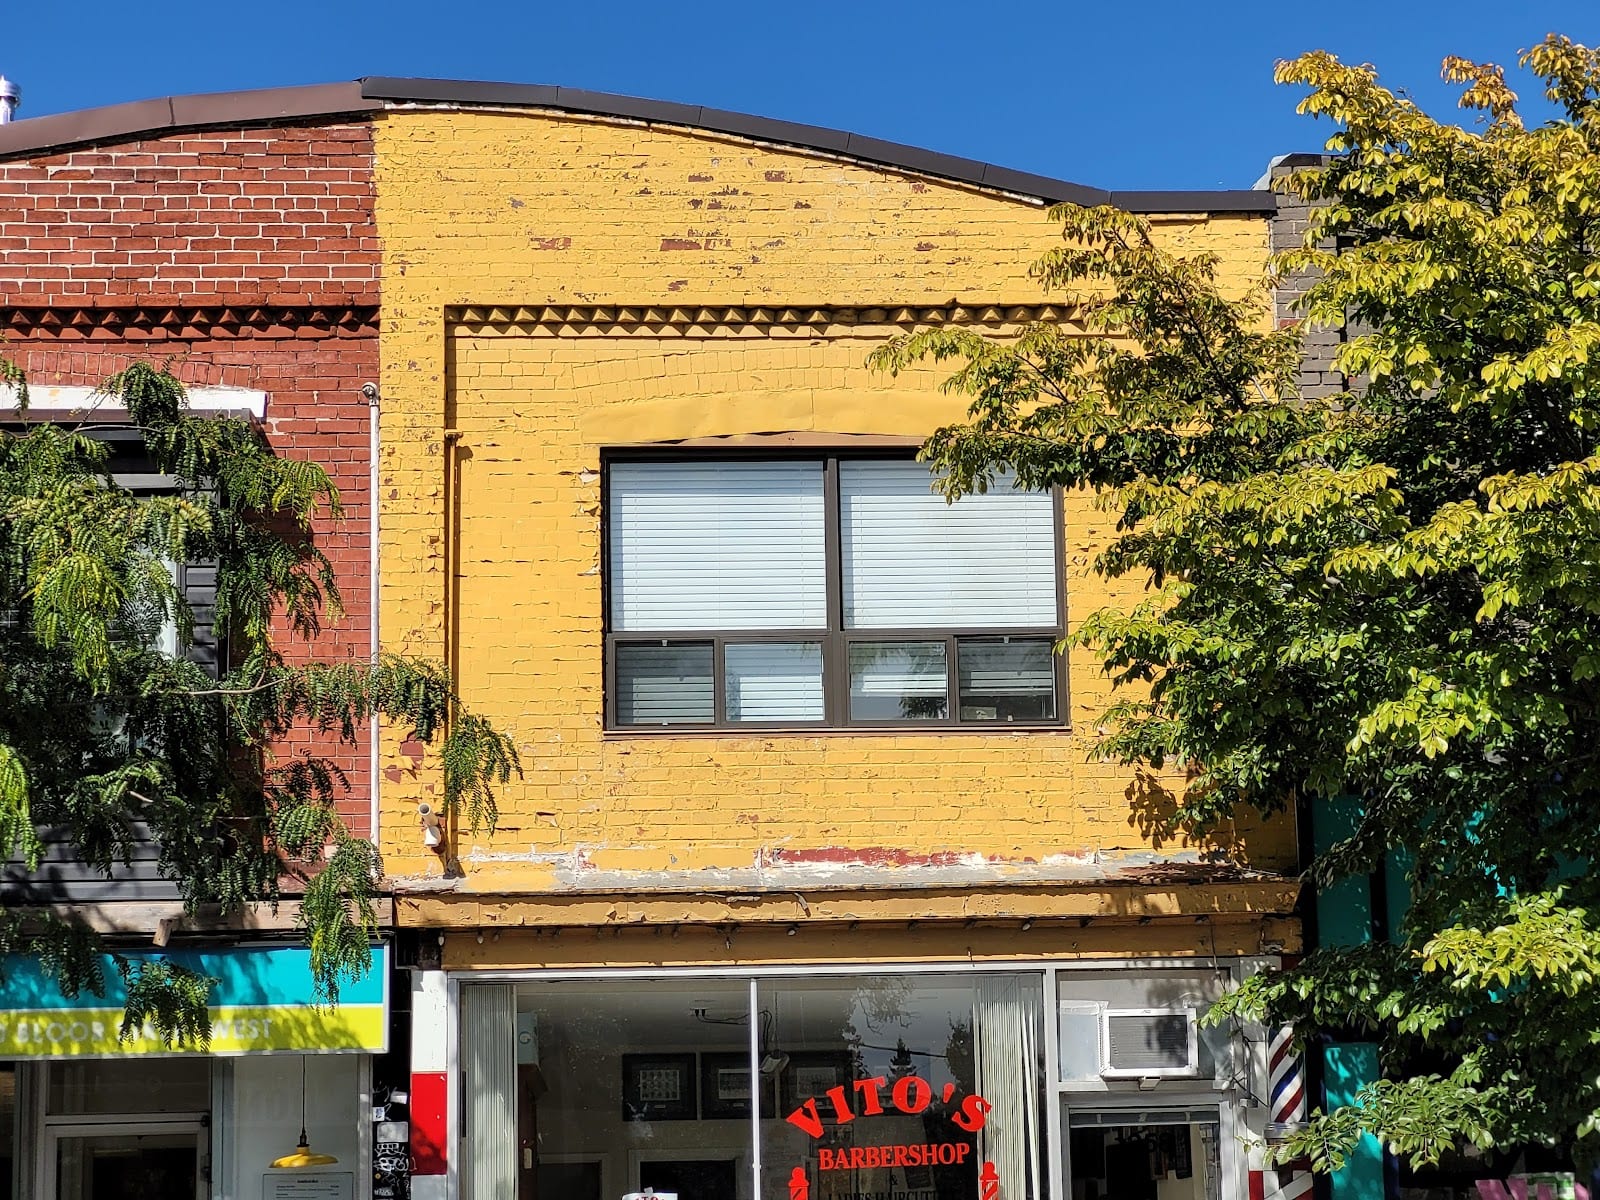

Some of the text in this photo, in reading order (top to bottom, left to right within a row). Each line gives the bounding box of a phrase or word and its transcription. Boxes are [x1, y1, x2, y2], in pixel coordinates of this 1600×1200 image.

[211, 1018, 273, 1041] WEST
[786, 1075, 992, 1140] VITO'S
[818, 1142, 970, 1171] BARBERSHOP
